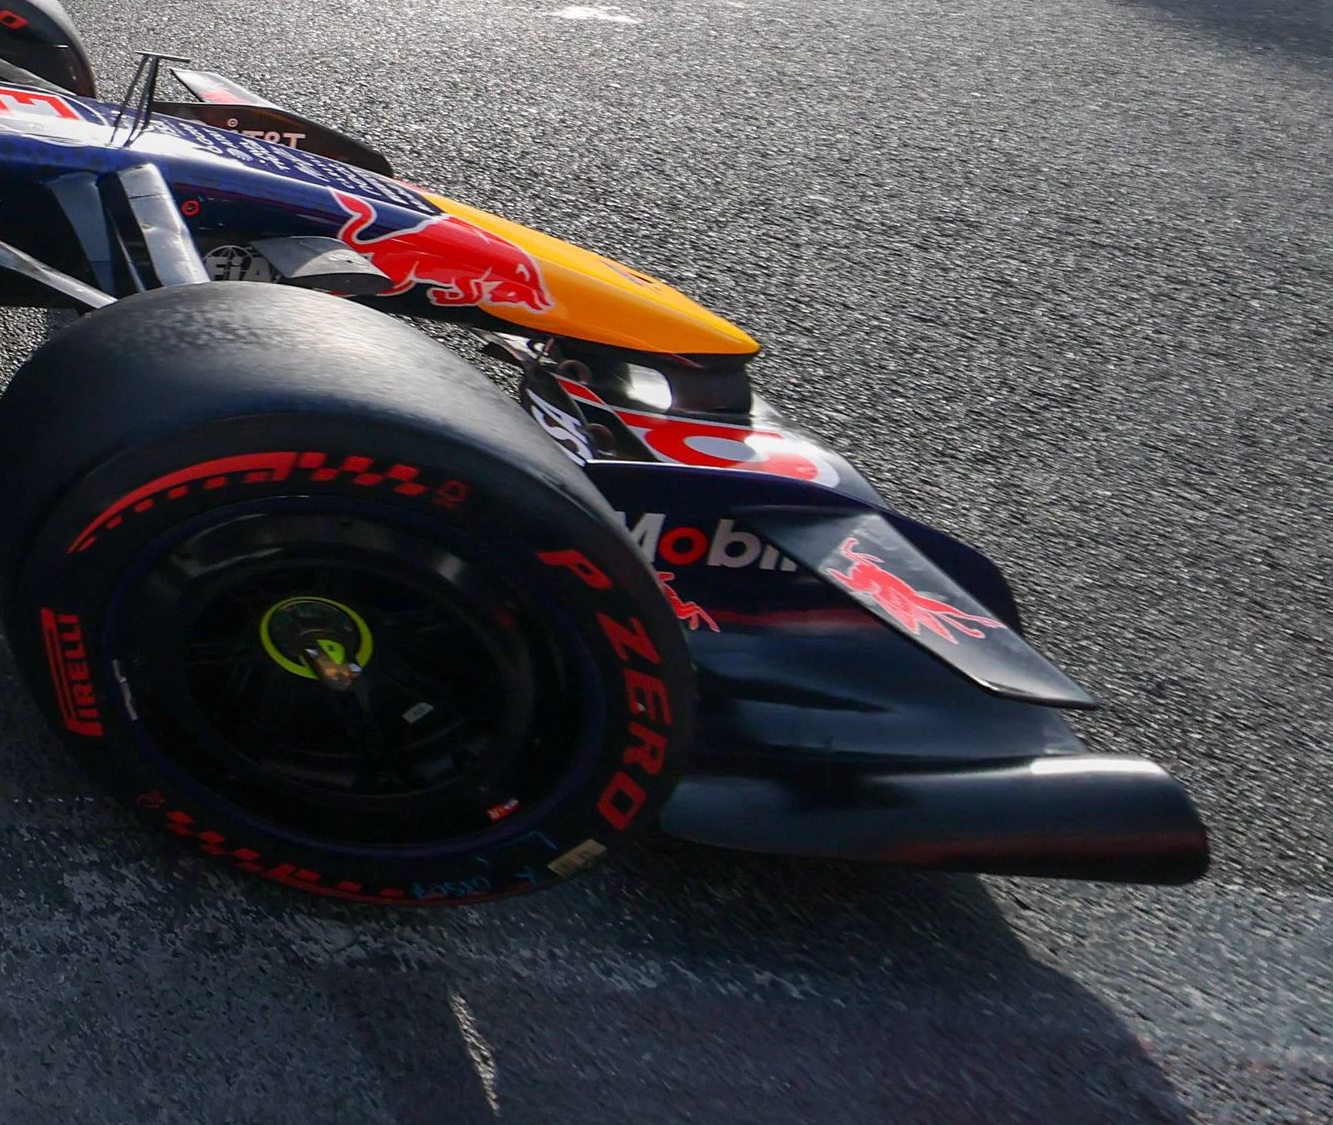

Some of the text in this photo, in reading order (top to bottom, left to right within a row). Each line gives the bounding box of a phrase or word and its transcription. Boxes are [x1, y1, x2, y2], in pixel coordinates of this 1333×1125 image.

[40, 607, 103, 738] PIRELLI
[538, 548, 672, 831] P ZERO
